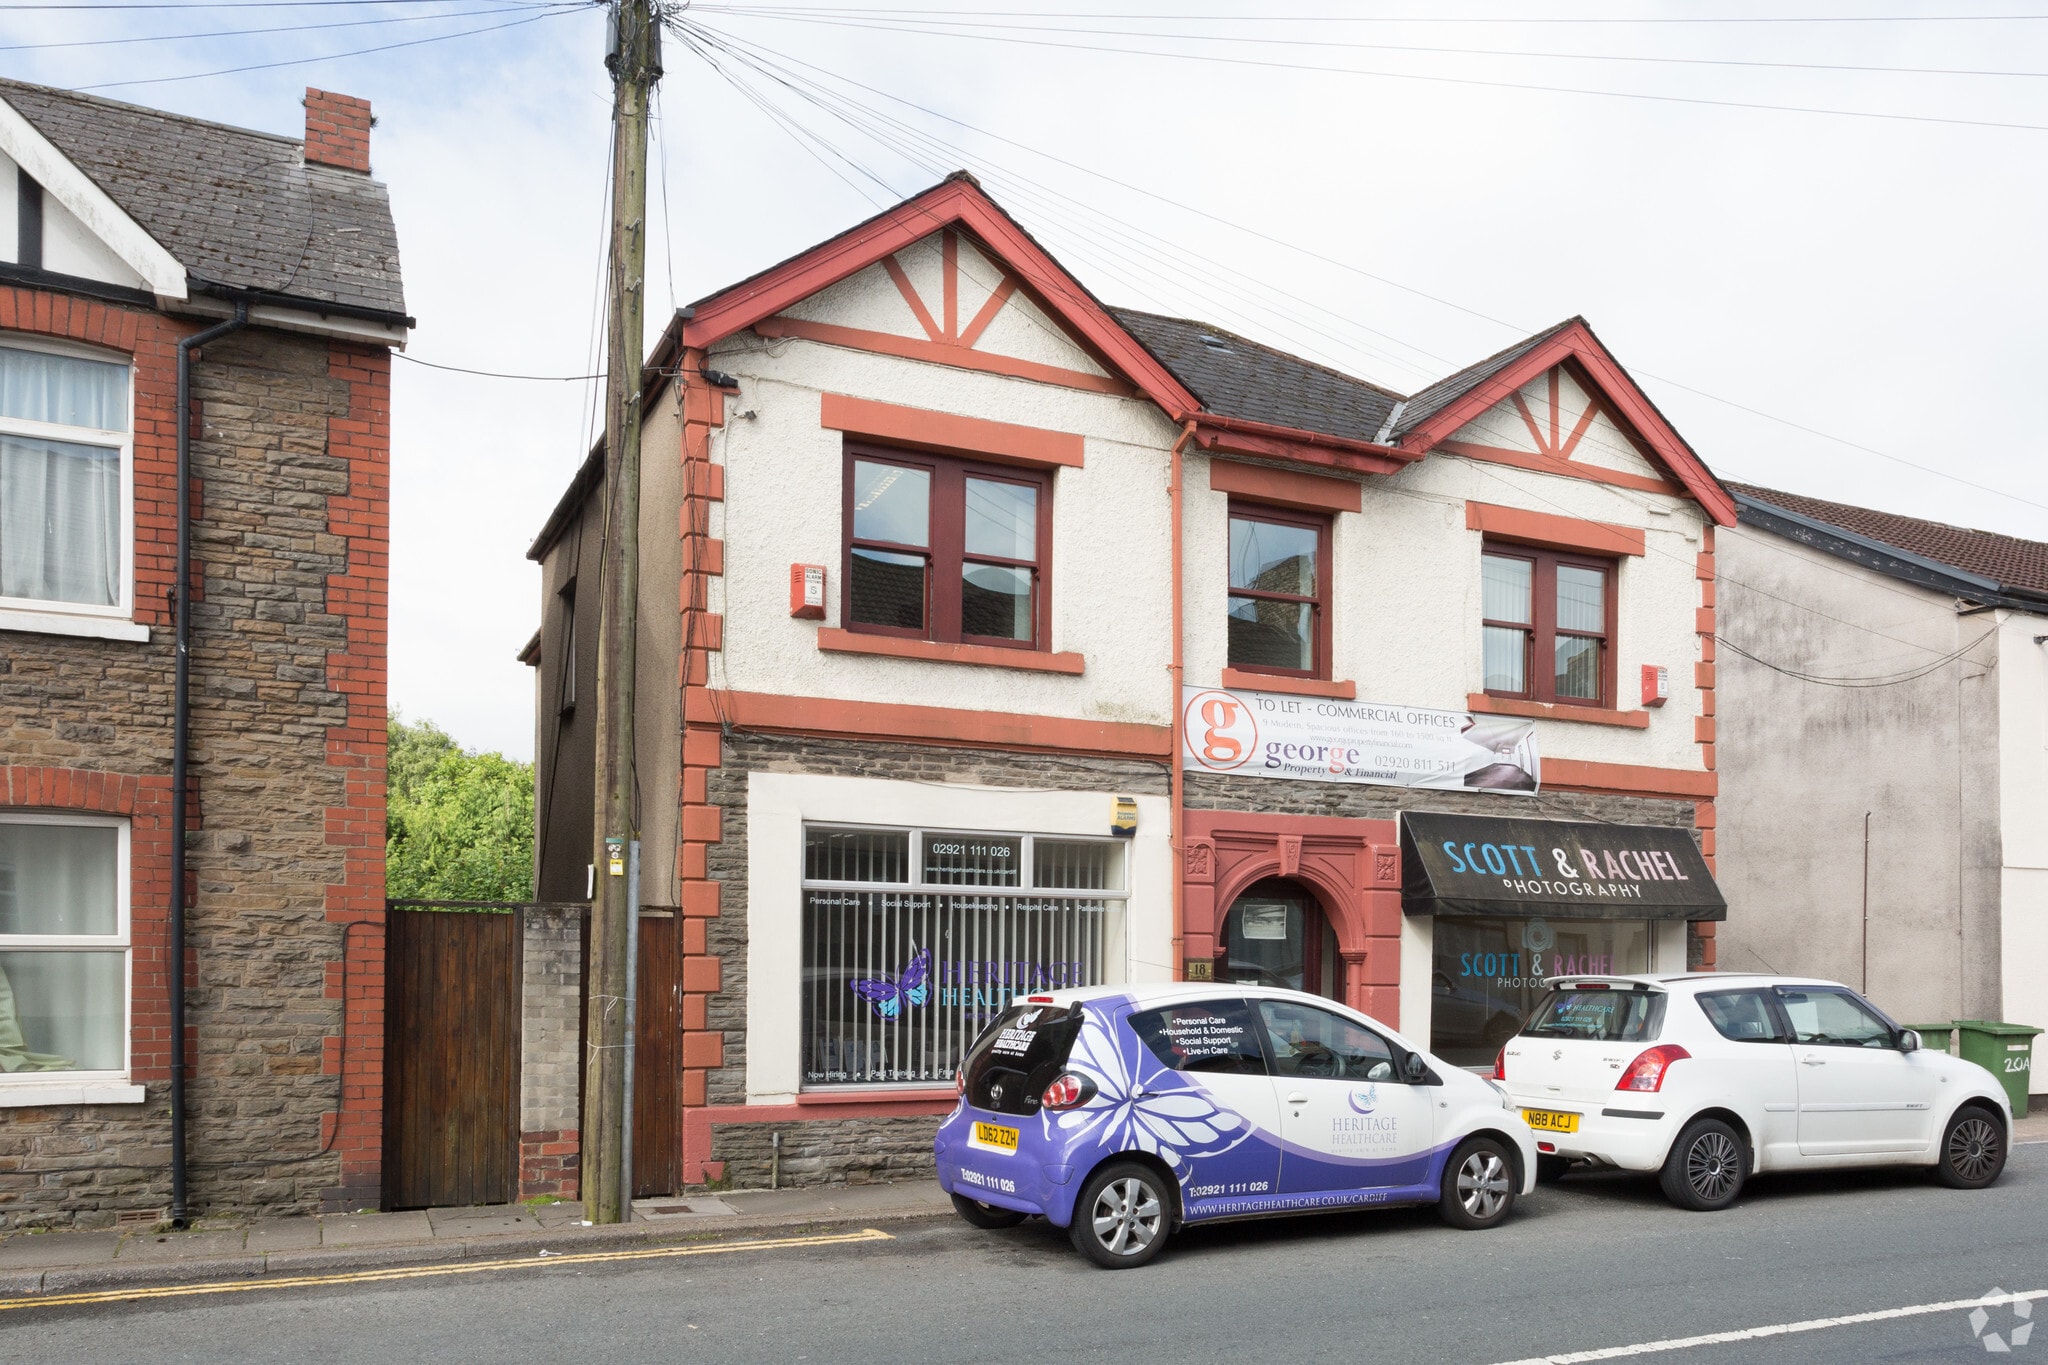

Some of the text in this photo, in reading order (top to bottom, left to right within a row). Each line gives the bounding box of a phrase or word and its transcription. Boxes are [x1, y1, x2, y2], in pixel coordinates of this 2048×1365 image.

[1256, 698, 1455, 728] TO LET COMMERCIAL OFFICES
[1306, 721, 1341, 733] Spacious
[1343, 726, 1368, 736] offices
[1371, 728, 1388, 737] from
[1406, 731, 1415, 739] to
[1265, 742, 1360, 774] george
[1374, 755, 1410, 769] 02920
[1414, 757, 1432, 771] 811
[1283, 762, 1398, 780] Property & Financial
[933, 843, 1011, 857] 02921 111 026
[1443, 841, 1689, 881] SCOTT & RACHEL
[810, 897, 841, 905] Personal
[843, 898, 860, 906] Care
[881, 899, 903, 907] Social
[904, 899, 931, 909] Support
[951, 902, 998, 911] Housekeeping
[1017, 903, 1042, 912] Respite
[1195, 963, 1206, 975] 18
[1460, 952, 1616, 977] SCOTT & RACHEL
[941, 960, 1085, 986] HERITAGE
[1573, 1004, 1616, 1014] HEALTHCARE
[1176, 1016, 1226, 1025] Personal Care
[999, 1028, 1037, 1042] HERITAGE
[1163, 1025, 1244, 1036] Household & Domestic
[994, 1038, 1031, 1051] HEALTHCARE
[1180, 1036, 1231, 1045] Social Support
[1186, 1046, 1228, 1055] Live-in Care
[2004, 1056, 2031, 1073] 20A
[827, 1070, 847, 1079] Hiring
[871, 1069, 887, 1077] Paid
[888, 1069, 916, 1078] Training
[939, 1068, 954, 1076] Free
[1332, 1117, 1398, 1131] HERITAGE
[1528, 1111, 1571, 1128] N88 ACJ
[978, 1124, 1017, 1146] LD62 ZZH
[1332, 1132, 1398, 1145] HEALTHCARE
[986, 1175, 999, 1189] 111
[1000, 1178, 1016, 1192] 026
[1189, 1181, 1269, 1198] T:02921 111 026
